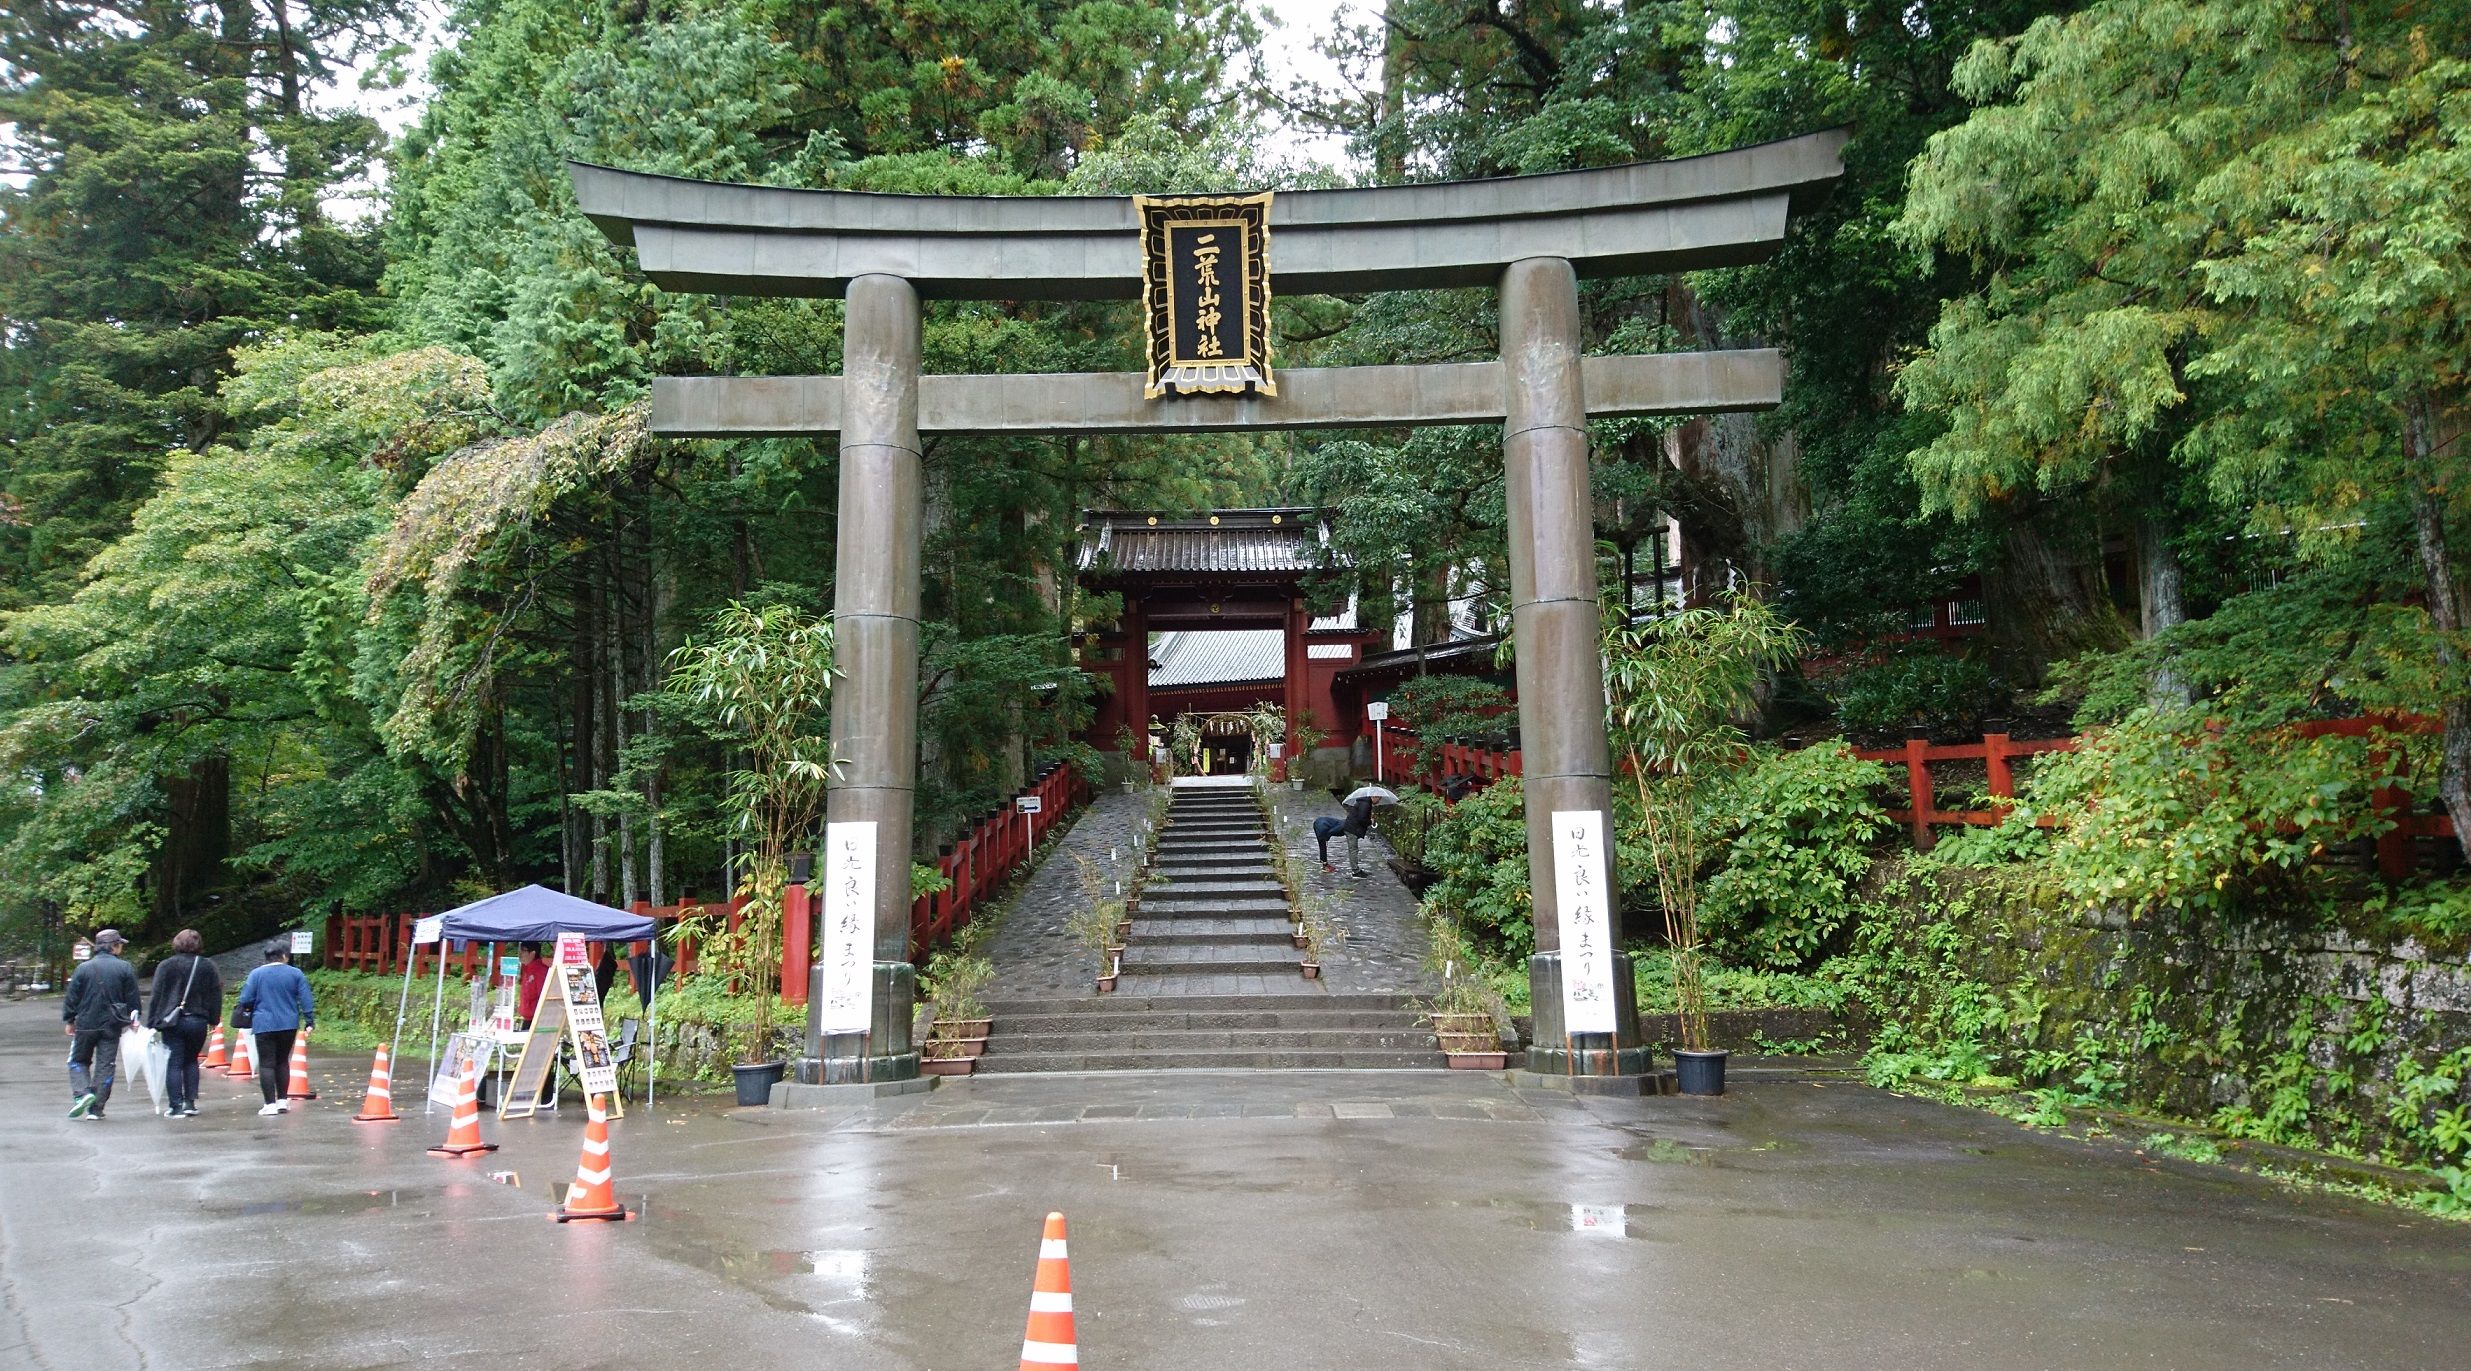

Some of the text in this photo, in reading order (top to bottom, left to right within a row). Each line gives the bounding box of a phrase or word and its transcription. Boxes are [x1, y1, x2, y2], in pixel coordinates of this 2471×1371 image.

[1193, 233, 1224, 358] 二荒山神社
[840, 838, 862, 986] 日光良い縁まつり
[1571, 826, 1595, 976] 日光良い縁まつり
